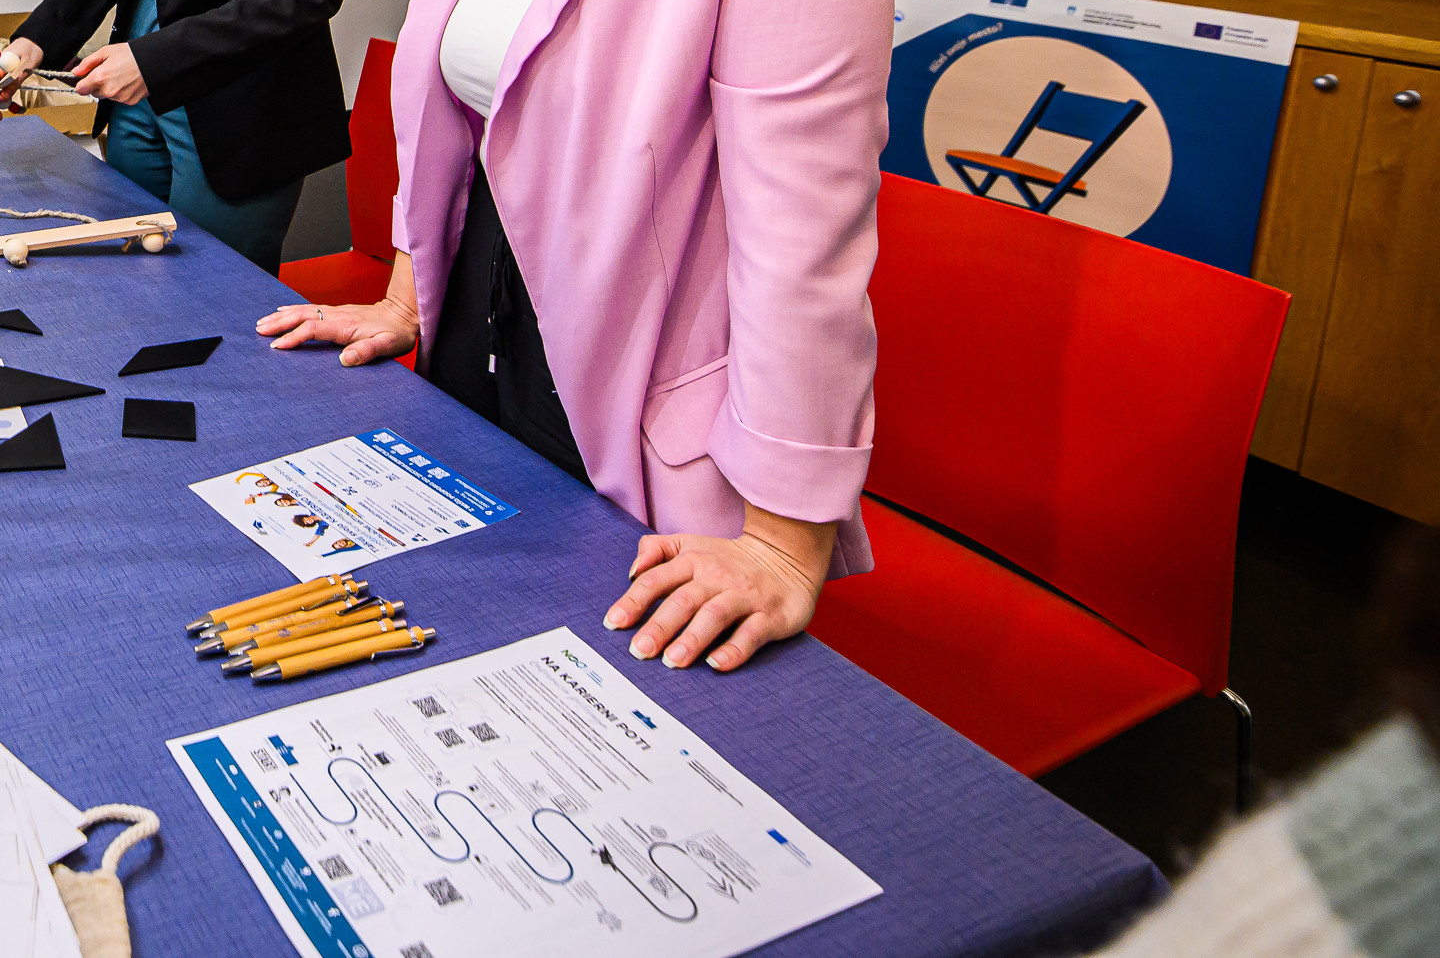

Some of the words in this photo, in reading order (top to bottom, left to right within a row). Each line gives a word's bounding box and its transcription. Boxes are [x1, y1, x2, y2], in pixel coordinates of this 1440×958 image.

[541, 656, 560, 672] NA
[560, 672, 619, 722] KARIERNI
[616, 722, 651, 751] POTI
